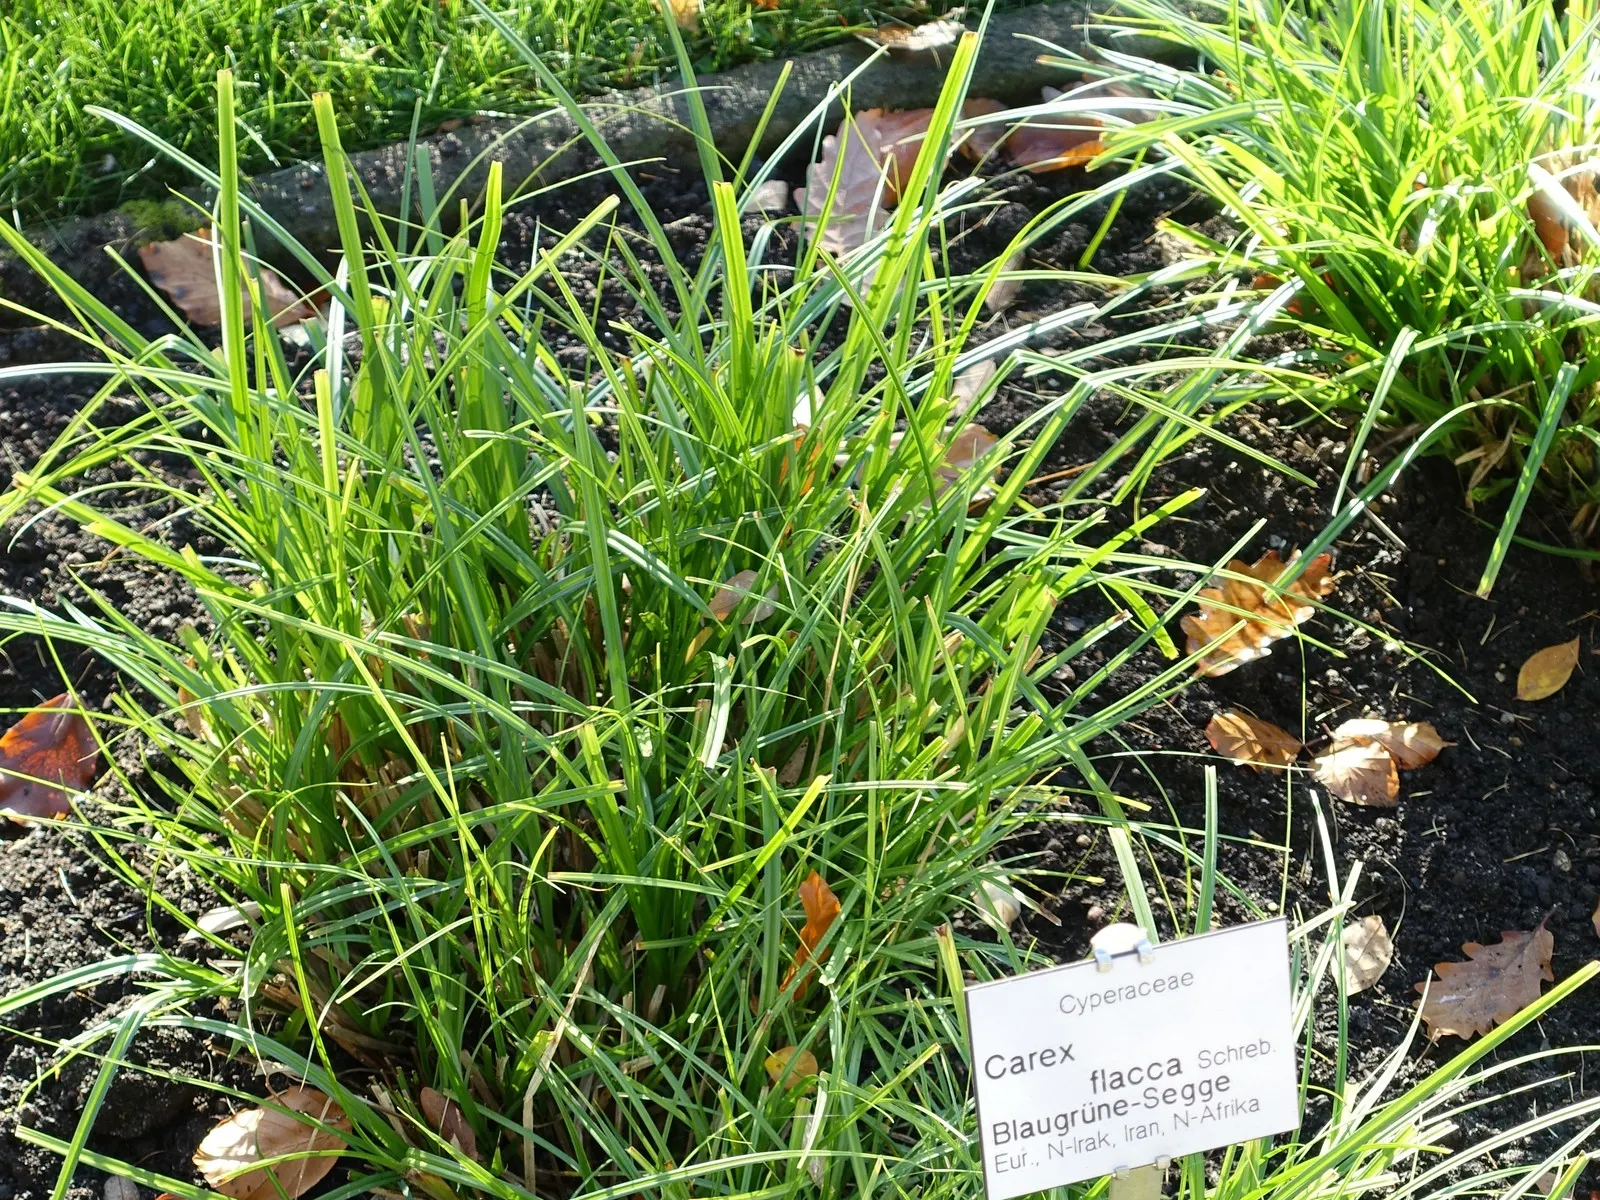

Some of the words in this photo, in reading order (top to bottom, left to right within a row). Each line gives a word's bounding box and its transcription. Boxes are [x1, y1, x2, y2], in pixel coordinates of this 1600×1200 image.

[1059, 972, 1194, 1015] Cyperaceae
[984, 1043, 1075, 1080] Carex
[1090, 1057, 1183, 1094] flacca
[1197, 1038, 1276, 1069] Schreb.
[993, 1075, 1231, 1145] Blaugrüne-Segge
[1048, 1131, 1116, 1160] N-Irak,
[1124, 1120, 1165, 1142] Iran,
[1173, 1098, 1260, 1131] N-Afrika
